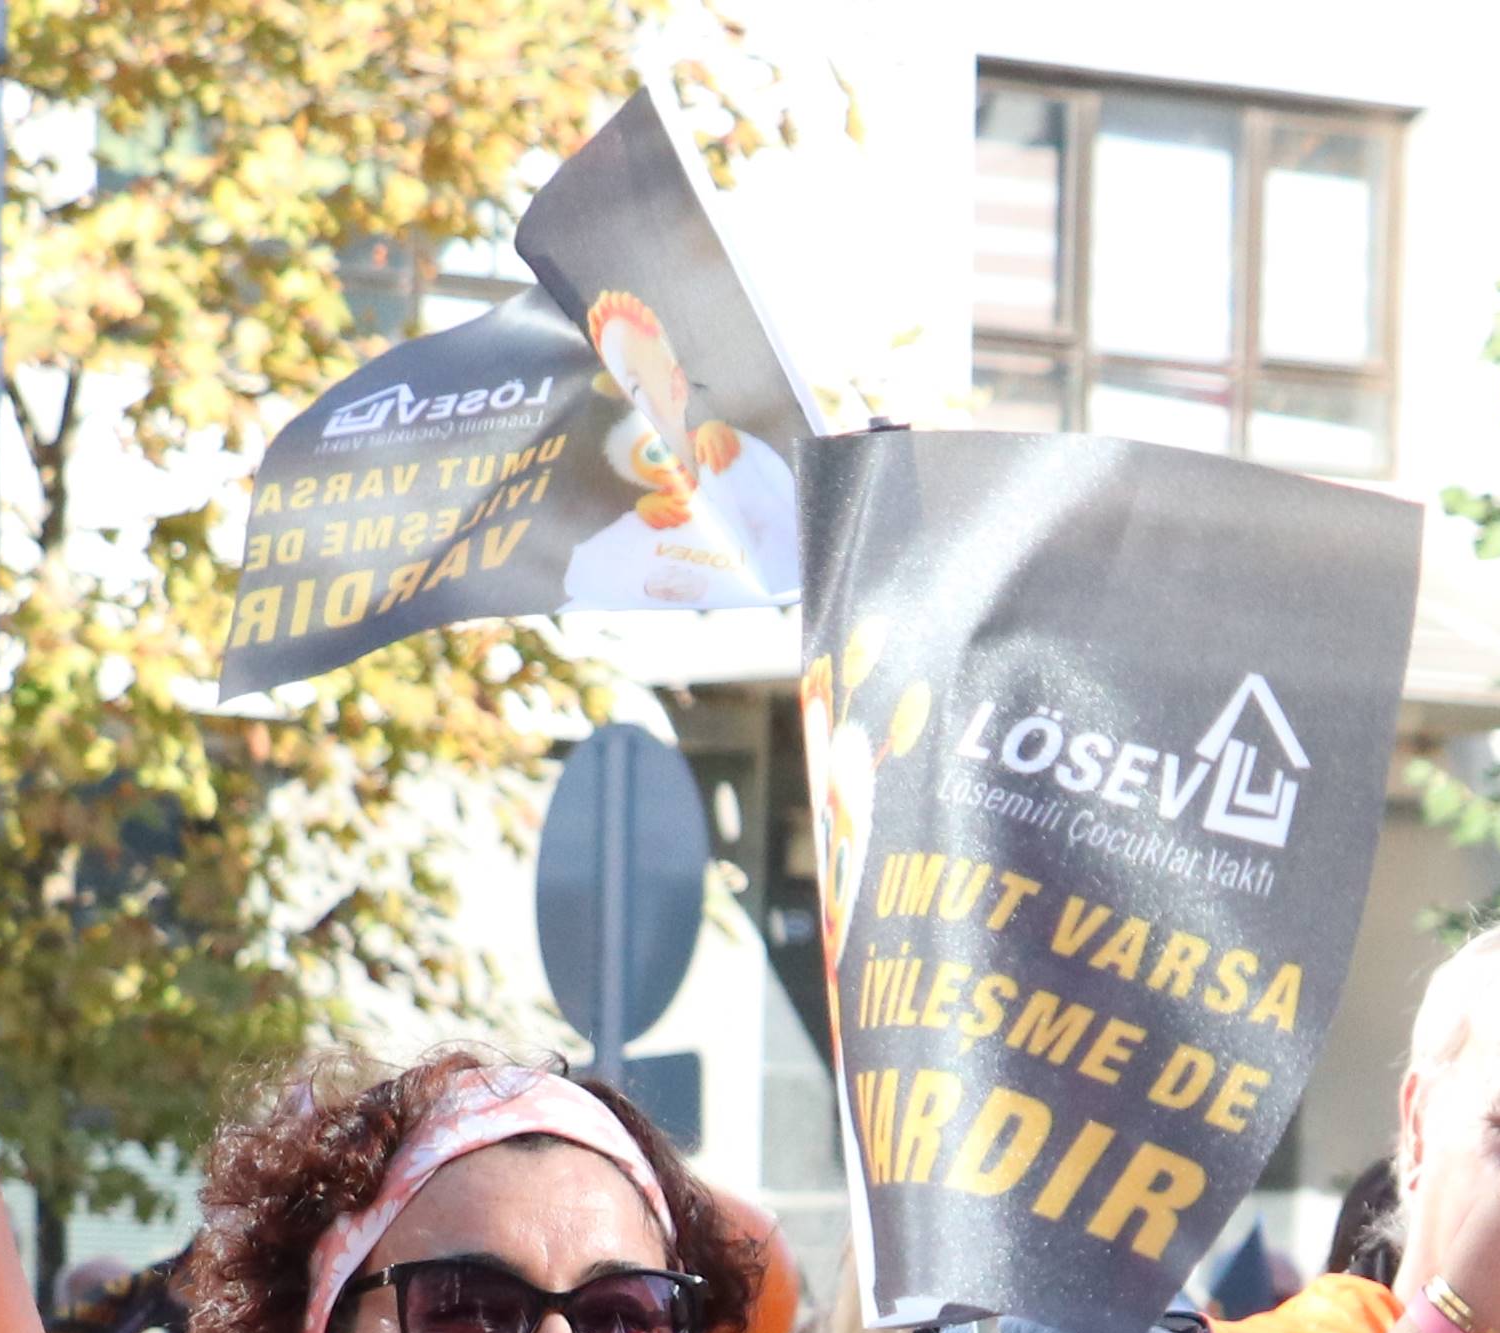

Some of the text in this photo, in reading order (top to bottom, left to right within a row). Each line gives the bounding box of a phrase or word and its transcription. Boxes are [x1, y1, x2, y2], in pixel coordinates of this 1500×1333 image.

[955, 700, 1212, 822] LÖSEV
[875, 852, 1303, 1034] UMUT VARSA
[1067, 809, 1203, 881] Çocuklar
[1208, 848, 1277, 898] Vakfı
[857, 941, 1273, 1135] İYİLEŞME DE
[856, 1067, 1208, 1262] VARDIR
